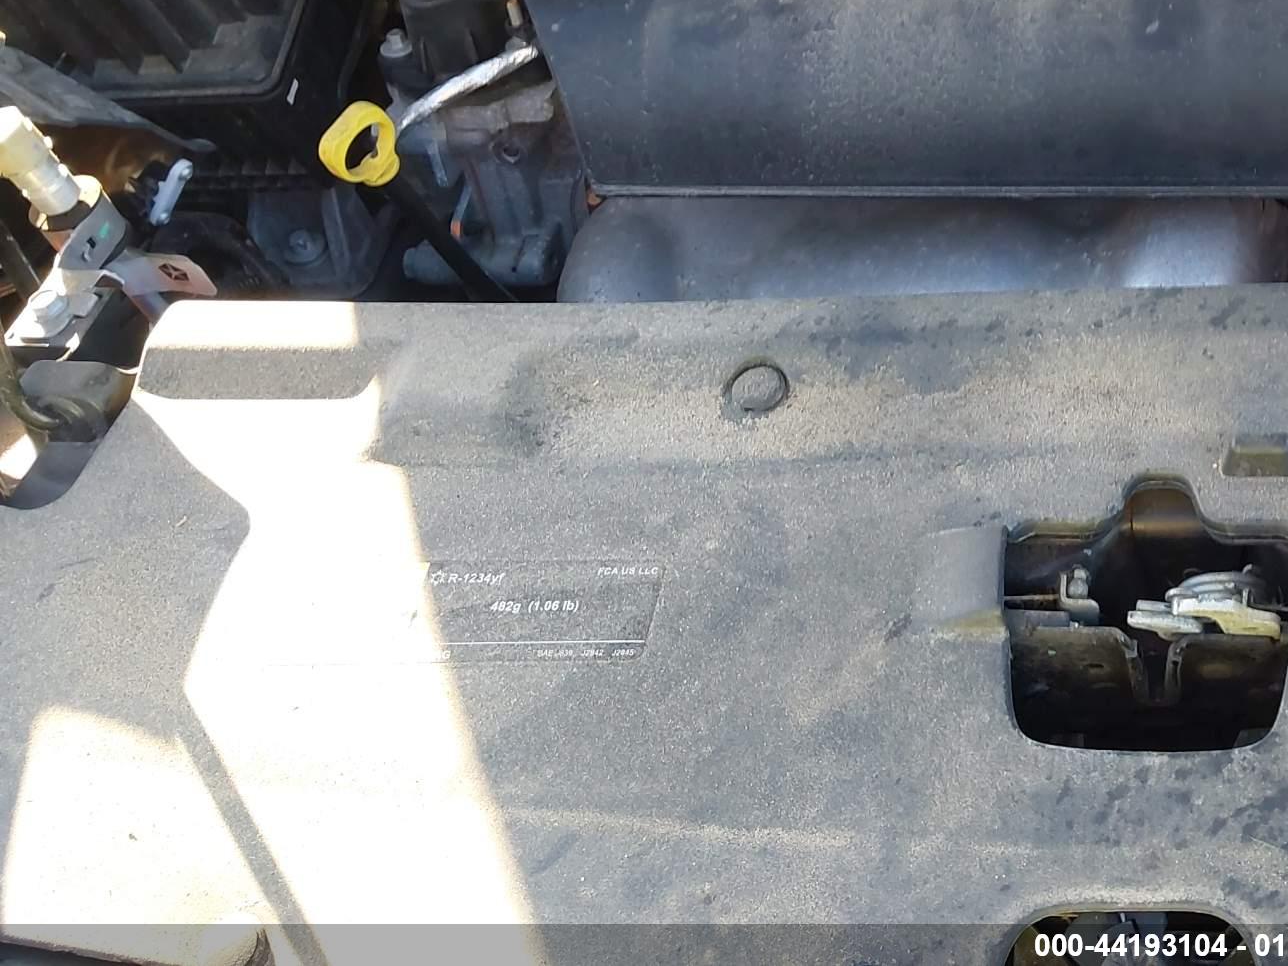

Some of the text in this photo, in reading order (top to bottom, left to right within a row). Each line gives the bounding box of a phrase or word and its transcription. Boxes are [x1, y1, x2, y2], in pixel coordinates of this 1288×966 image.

[447, 572, 506, 586] R-1234yf
[528, 600, 560, 614] (1.06
[562, 599, 579, 613] lb)
